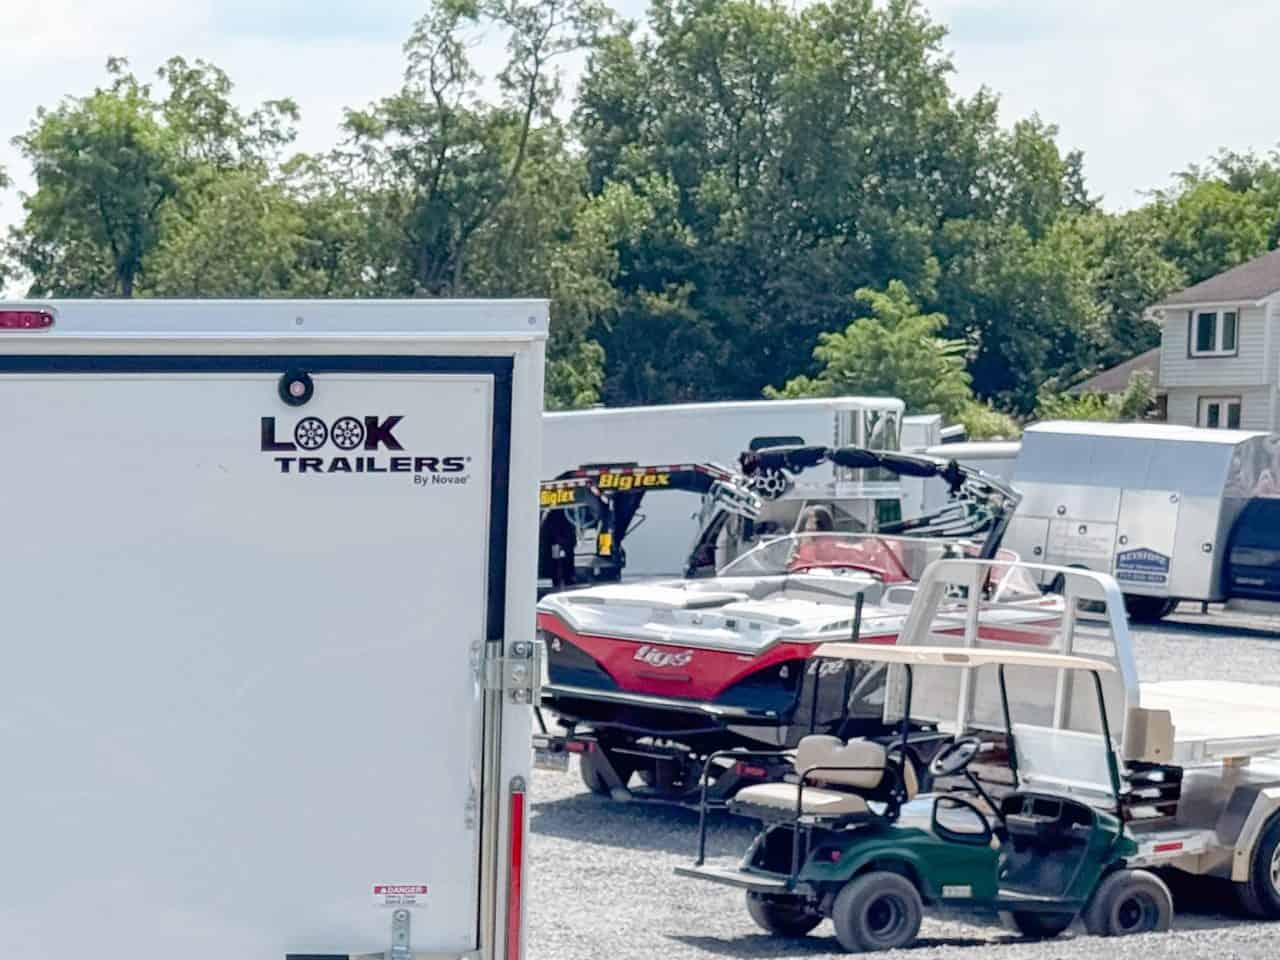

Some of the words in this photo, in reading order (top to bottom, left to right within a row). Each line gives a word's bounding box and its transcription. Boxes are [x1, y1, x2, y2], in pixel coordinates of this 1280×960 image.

[261, 416, 405, 451] LOOK
[274, 456, 466, 473] TRAILERS
[414, 475, 428, 486] By
[432, 475, 467, 485] Novae
